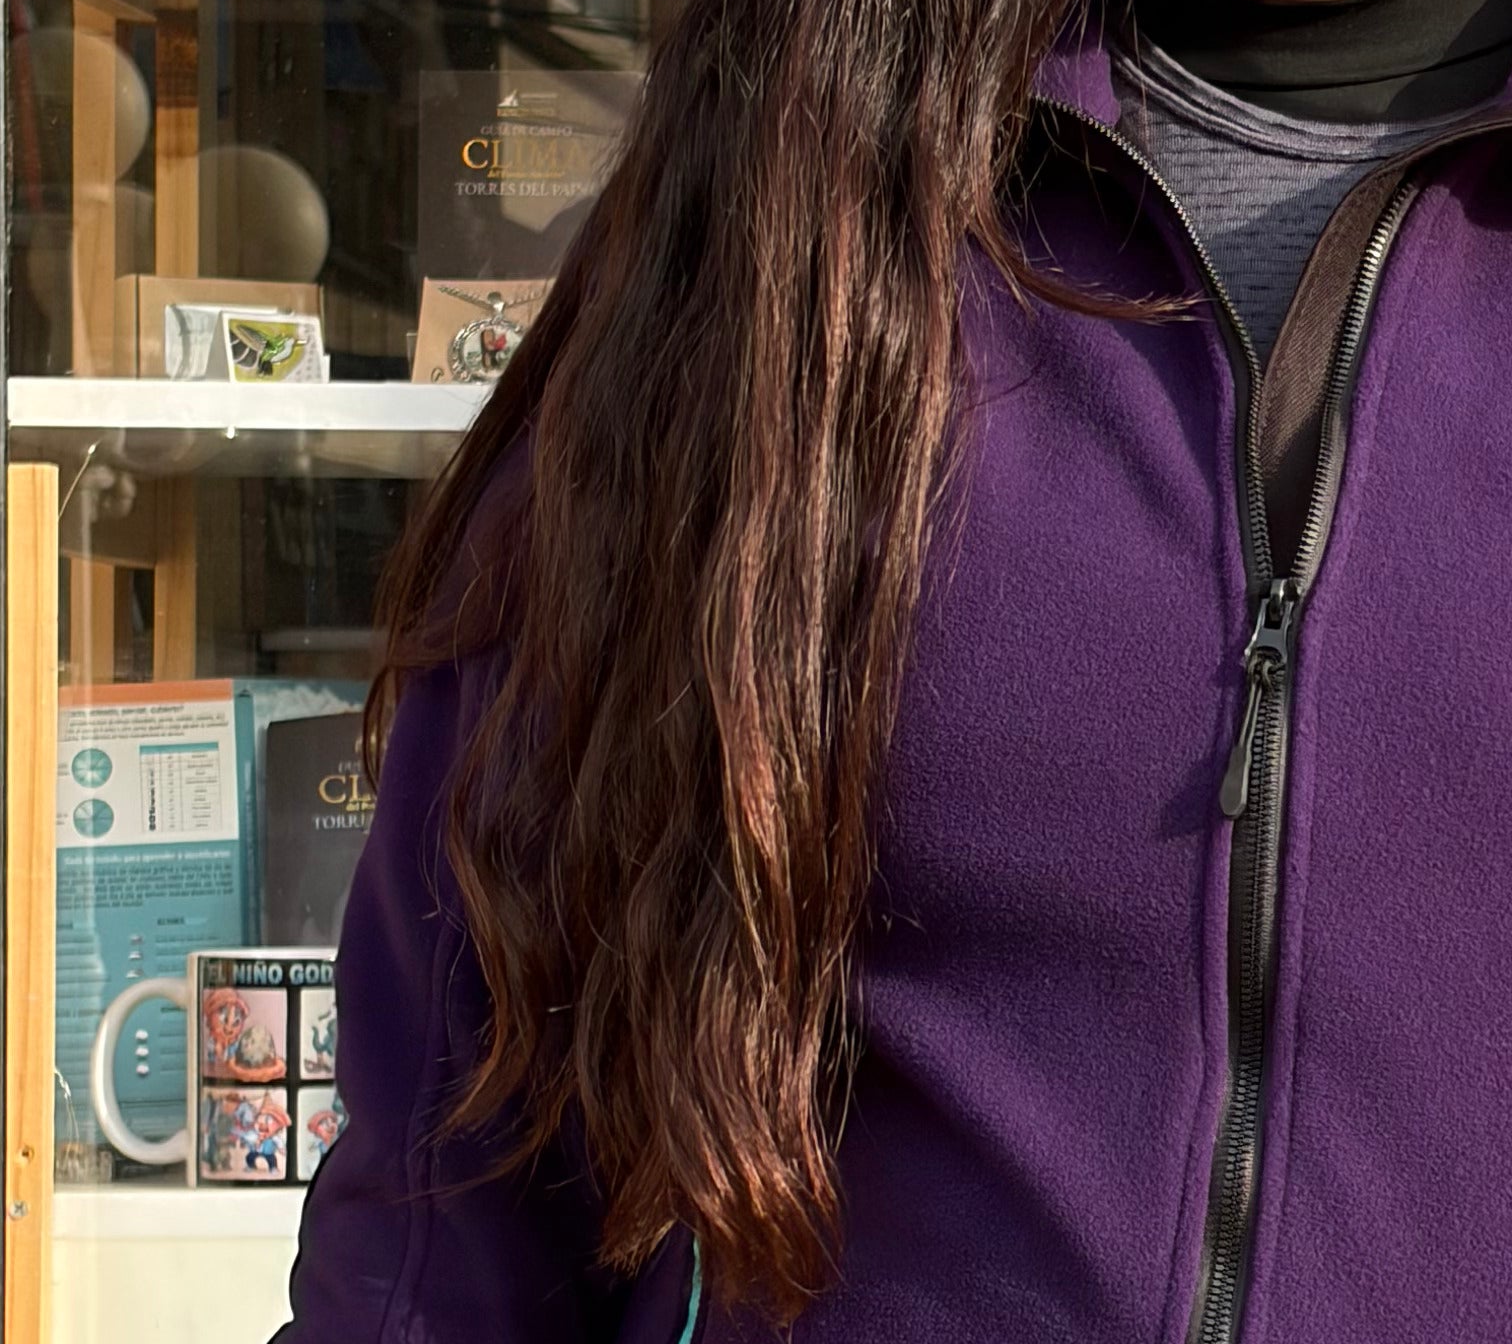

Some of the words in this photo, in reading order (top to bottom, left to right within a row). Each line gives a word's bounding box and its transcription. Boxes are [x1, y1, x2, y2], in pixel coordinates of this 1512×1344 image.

[456, 182, 515, 196] TORRES
[518, 181, 549, 197] DEL
[318, 774, 377, 804] CL
[233, 960, 284, 985] NIÑO
